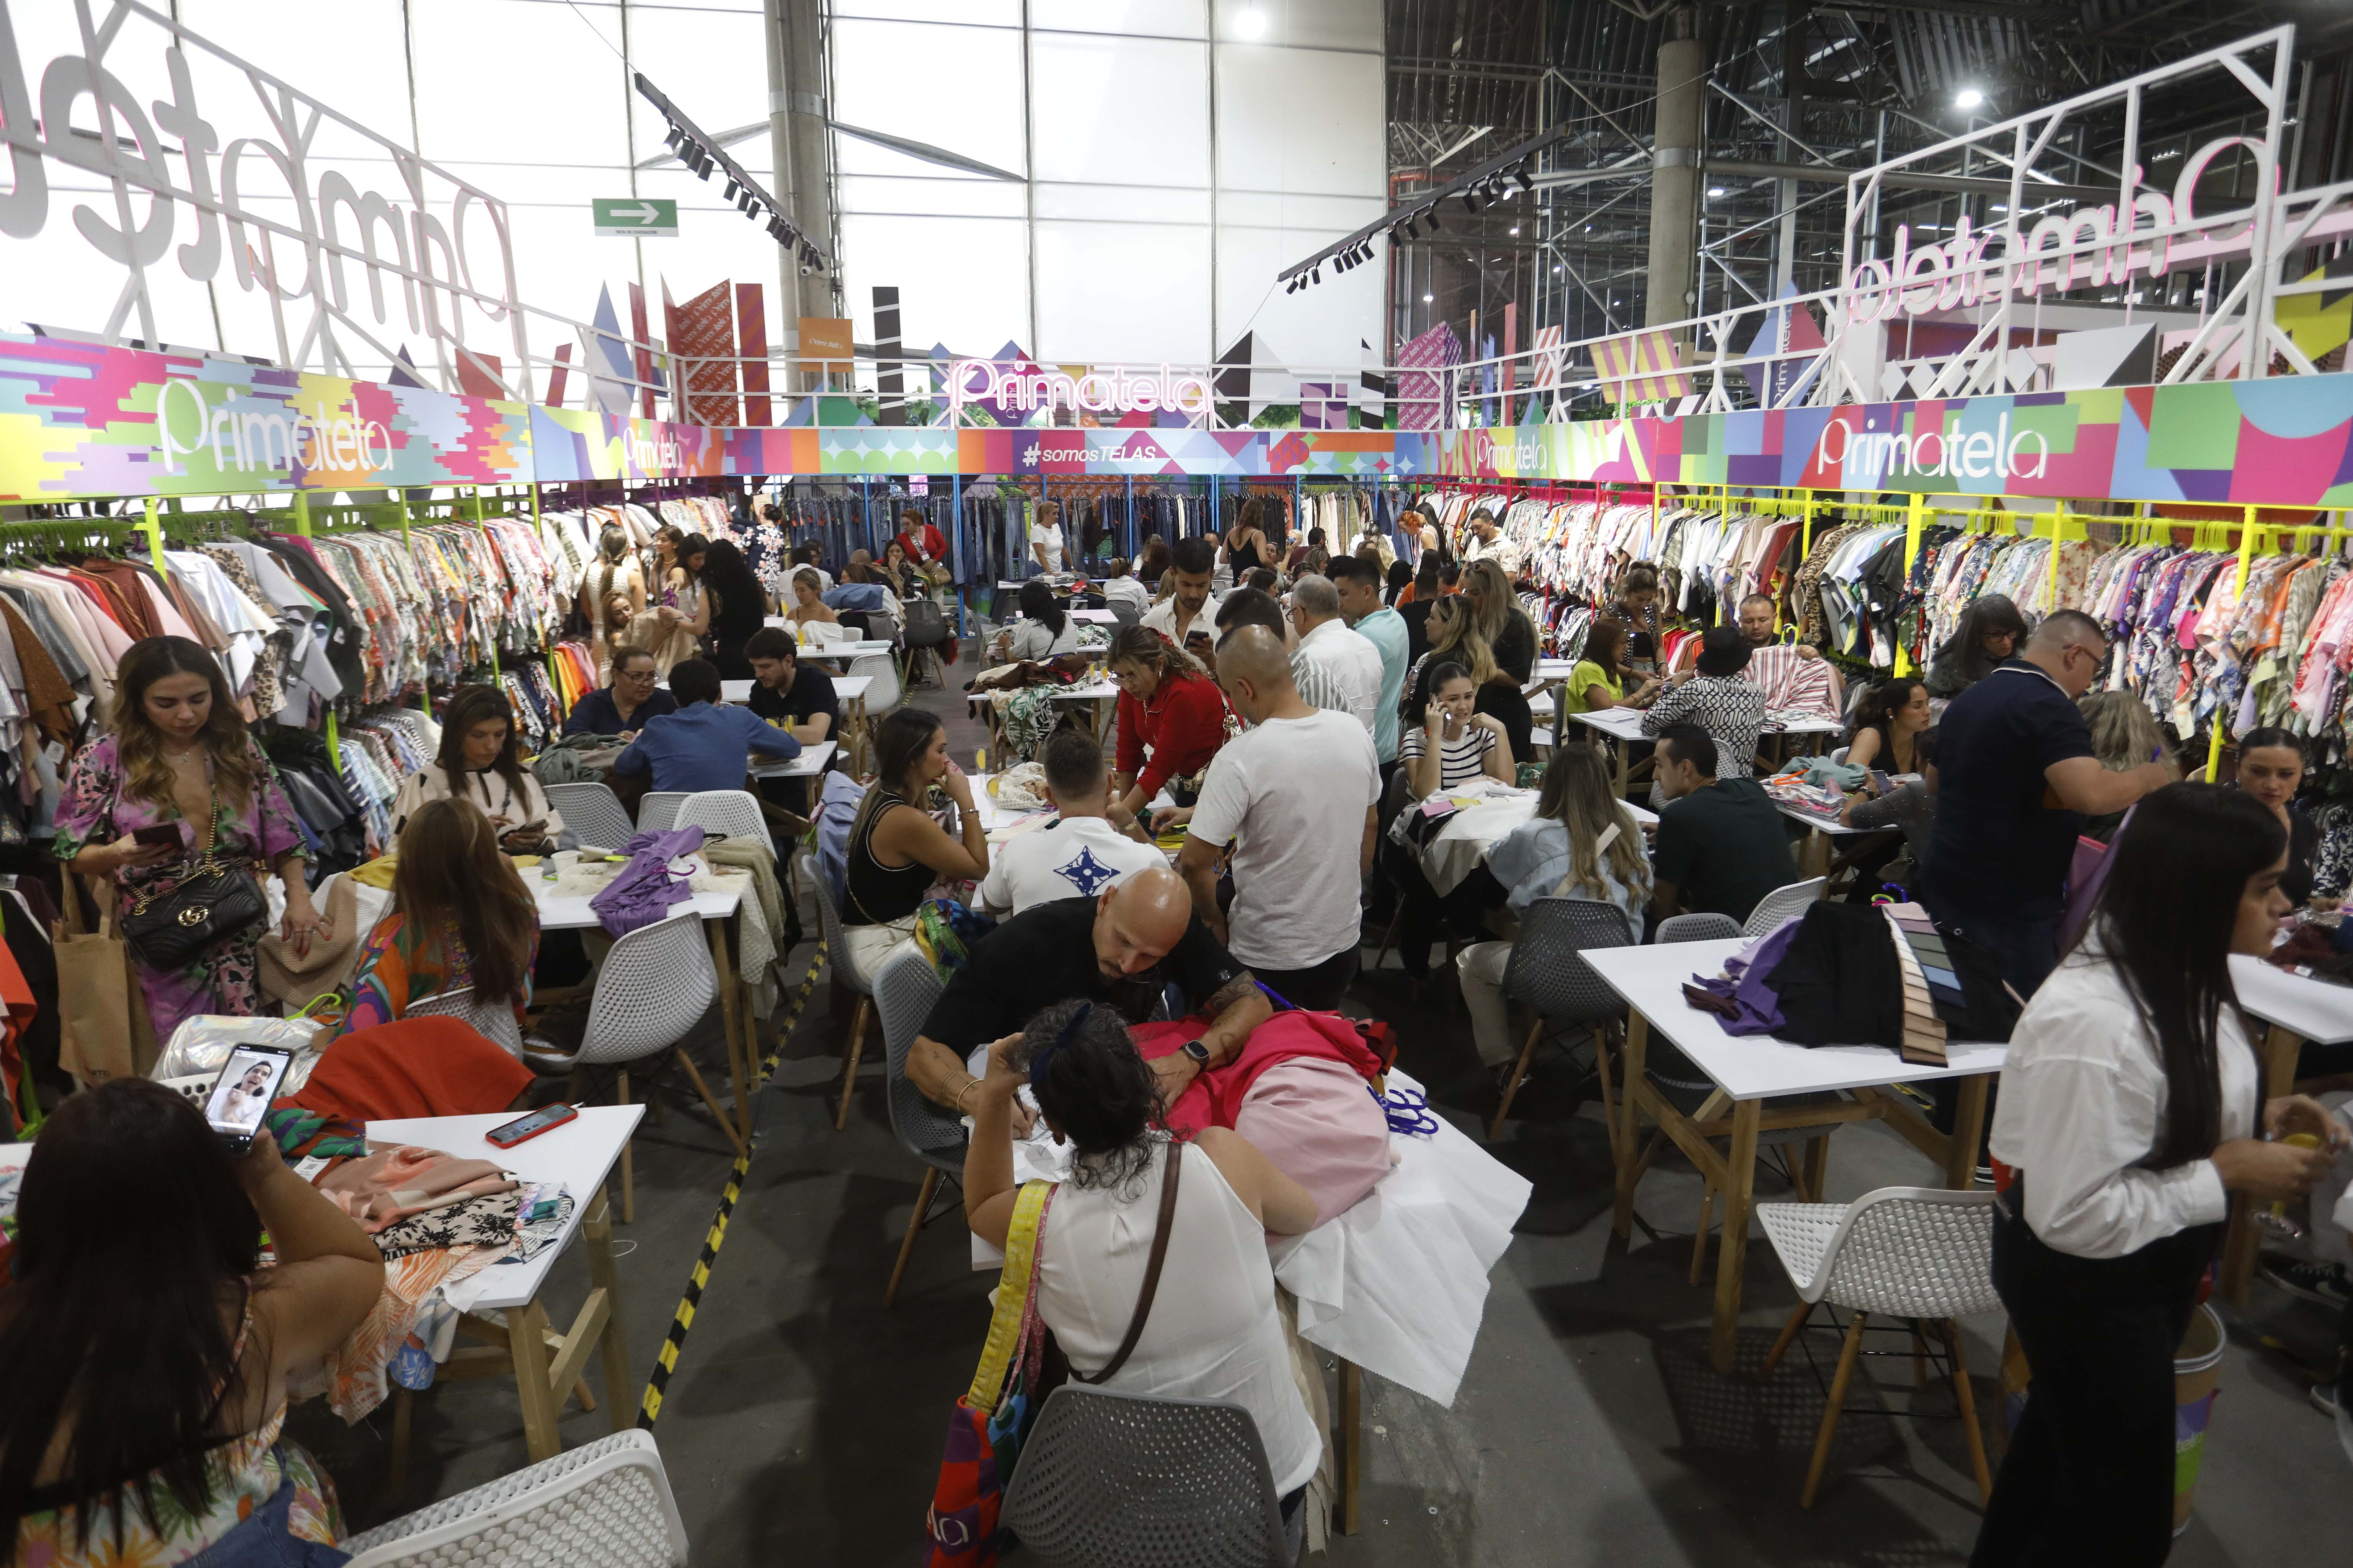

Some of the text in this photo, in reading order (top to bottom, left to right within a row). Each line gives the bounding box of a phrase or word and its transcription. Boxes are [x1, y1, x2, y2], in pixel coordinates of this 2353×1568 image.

[952, 359, 1211, 413] Primatela
[157, 379, 394, 472] Primatela
[623, 427, 682, 469] Primatela
[1817, 412, 2049, 479] Primatela
[1023, 442, 1156, 467] #somosTELAS
[1477, 434, 1547, 470] Primatela
